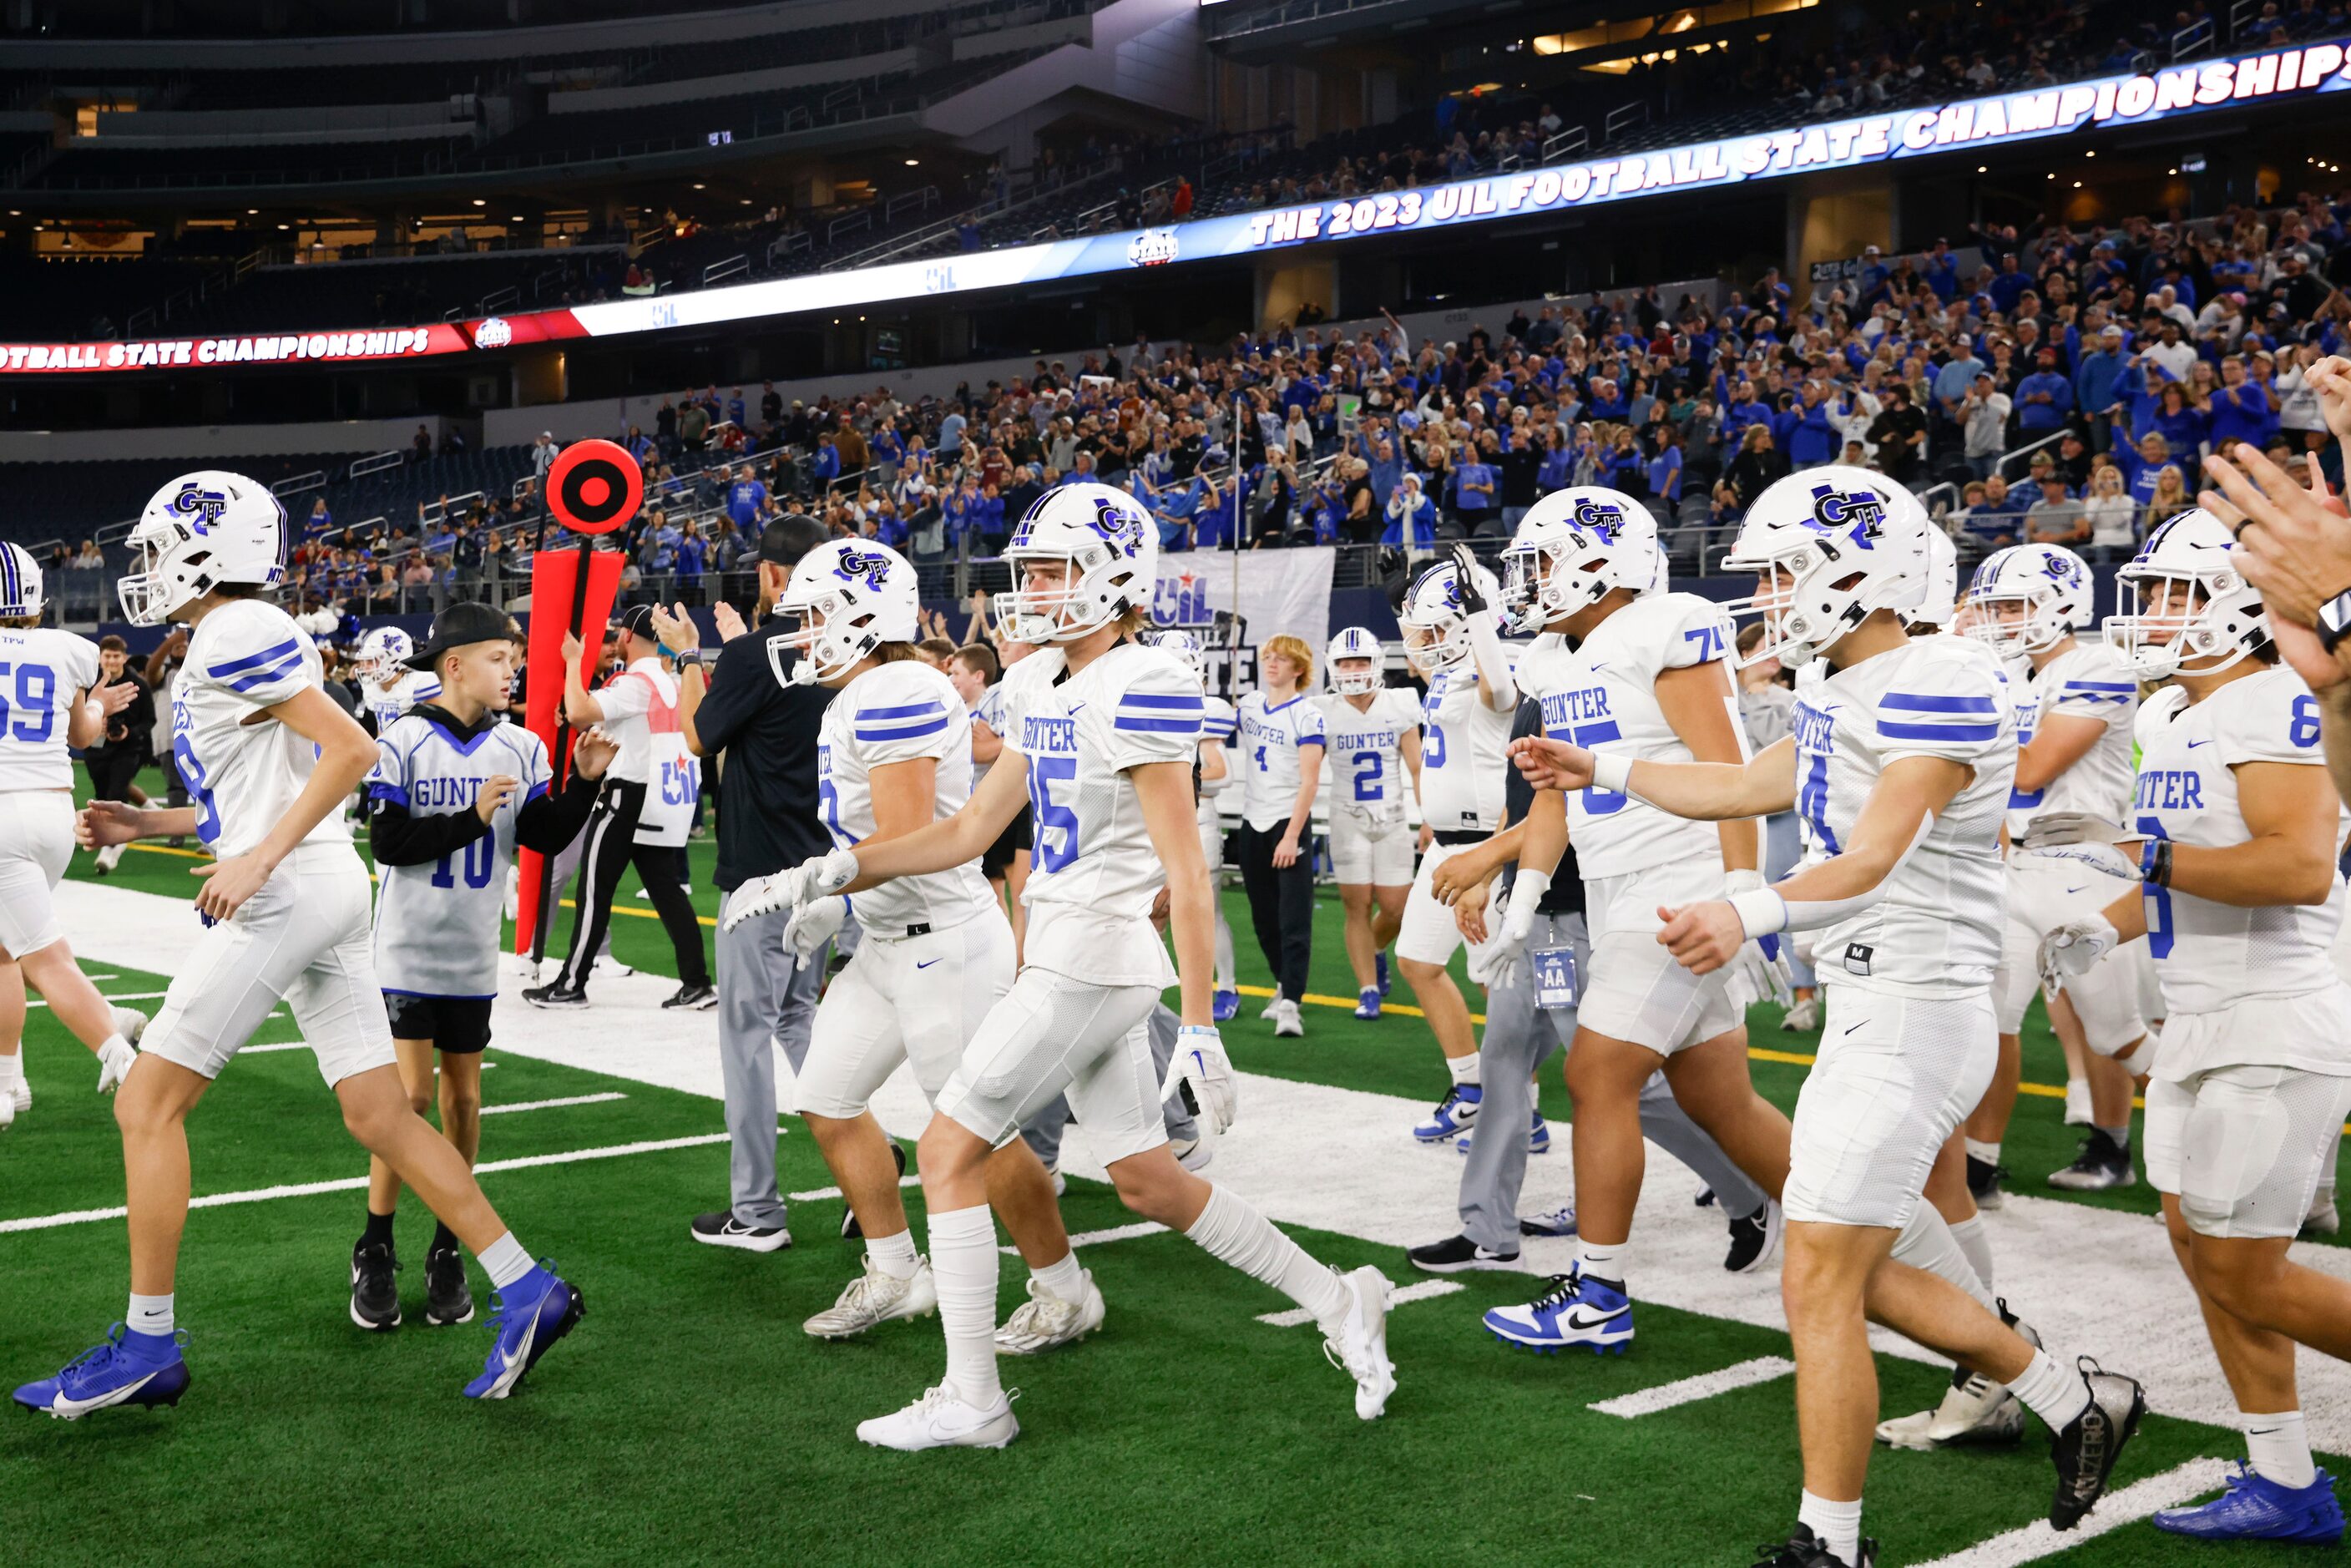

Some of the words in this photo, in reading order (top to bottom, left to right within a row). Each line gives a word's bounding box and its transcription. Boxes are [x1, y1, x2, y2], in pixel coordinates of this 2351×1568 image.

[1251, 207, 1322, 245] THE
[1328, 192, 1423, 235] 2023
[1431, 182, 1497, 220] UIL
[1508, 145, 1728, 210] FOOTBALL
[1741, 118, 1893, 174] STATE
[1902, 44, 2351, 149] CHAMPIONSHIP
[106, 341, 193, 367] STATE
[197, 328, 429, 363] CHAMPIONSHIPS
[1542, 686, 1611, 726] GUNTER
[1244, 717, 1285, 746] GUNTER
[1317, 716, 1324, 733] 4
[1337, 731, 1395, 751] GUNTER
[1254, 746, 1268, 772] 4
[1352, 751, 1383, 802] 2
[415, 777, 507, 808] GUNT
[1852, 946, 1863, 959] M
[1545, 969, 1566, 987] AA
